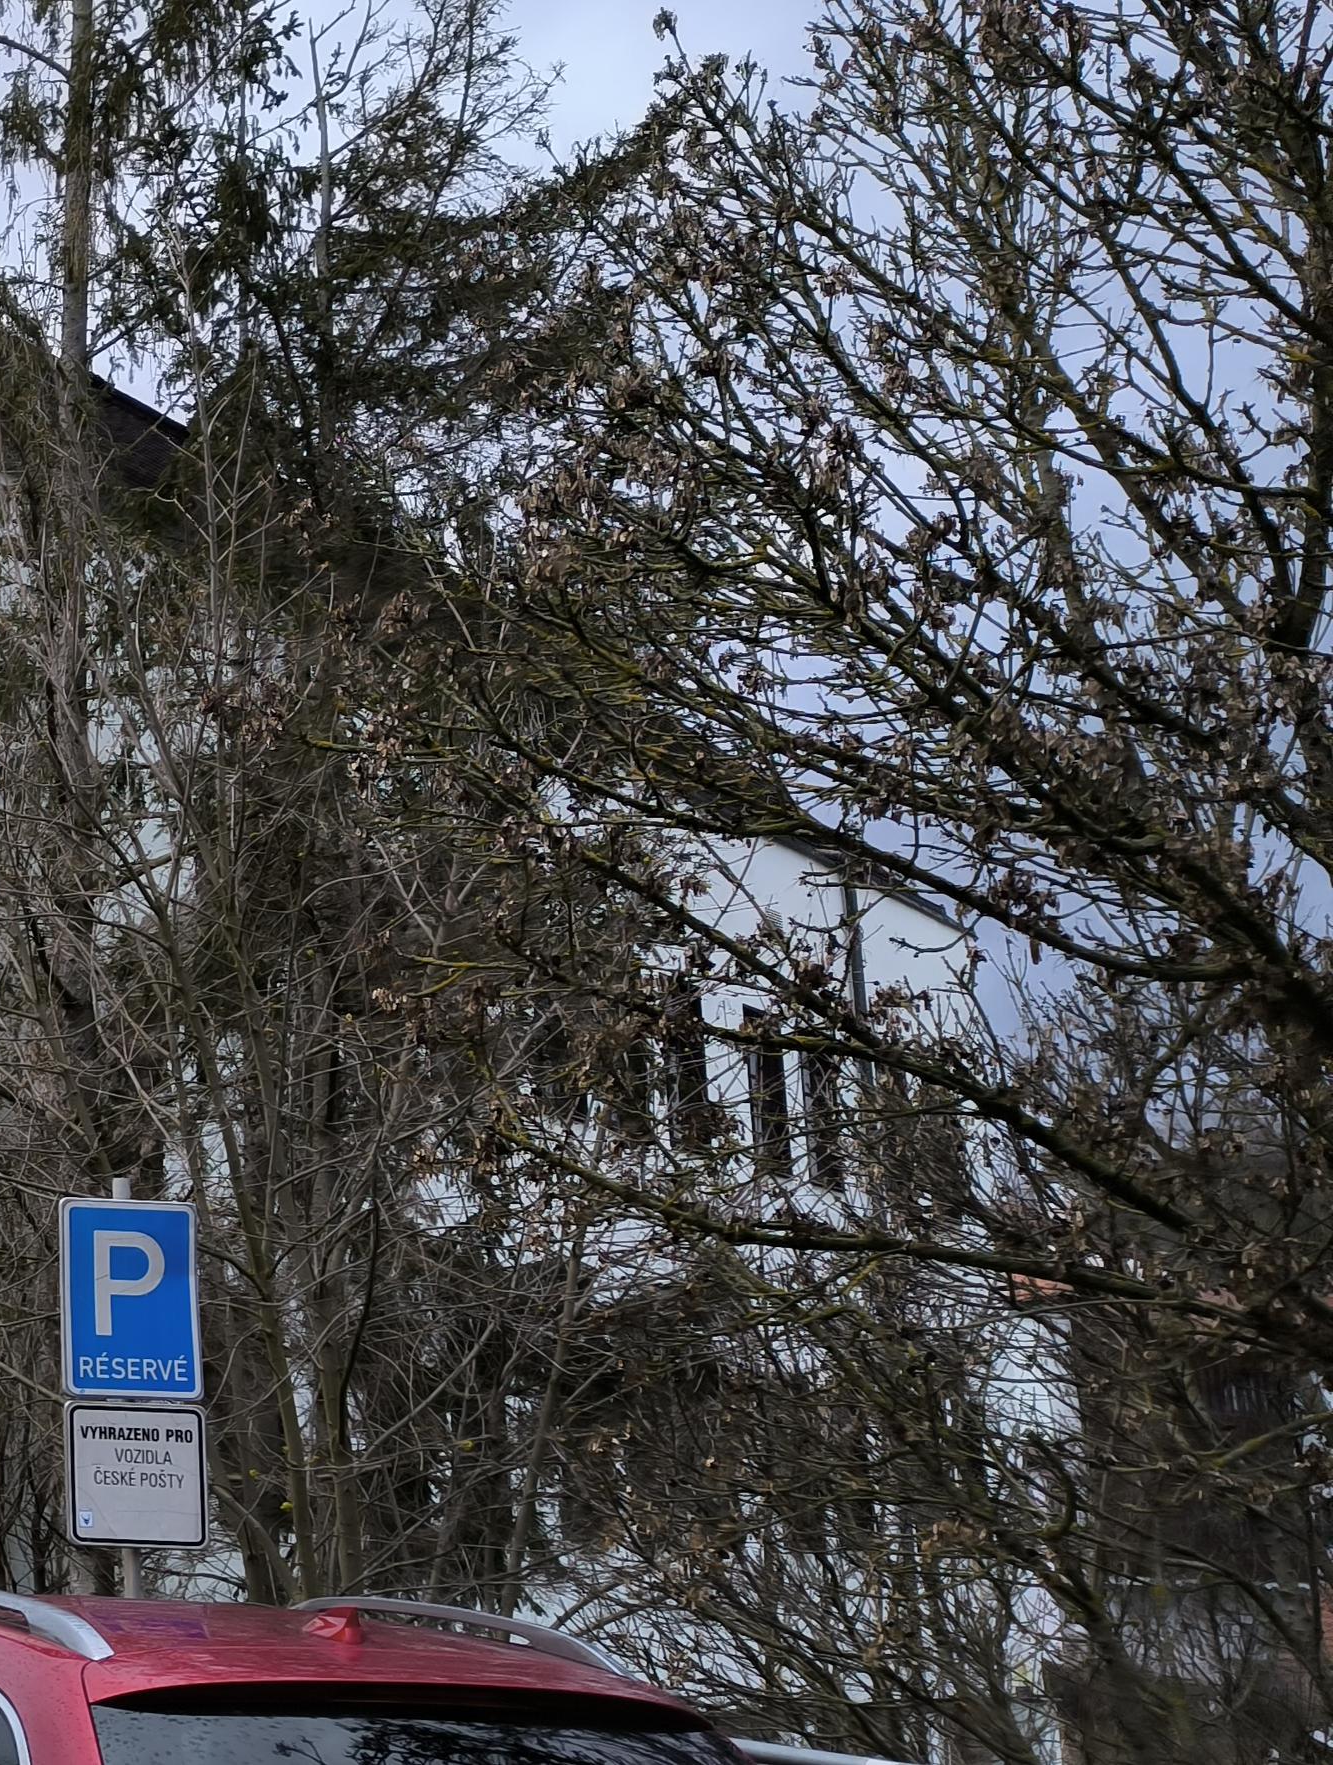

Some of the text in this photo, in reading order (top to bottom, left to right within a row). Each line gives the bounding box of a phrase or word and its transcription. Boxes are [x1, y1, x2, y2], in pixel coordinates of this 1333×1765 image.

[93, 1229, 165, 1336] P
[79, 1351, 189, 1382] RÉSERVÉ
[80, 1425, 193, 1444] VYHRAZENO PRO
[114, 1447, 173, 1465] VOZIDLA
[93, 1466, 185, 1489] ČESKÉ POŠTY
